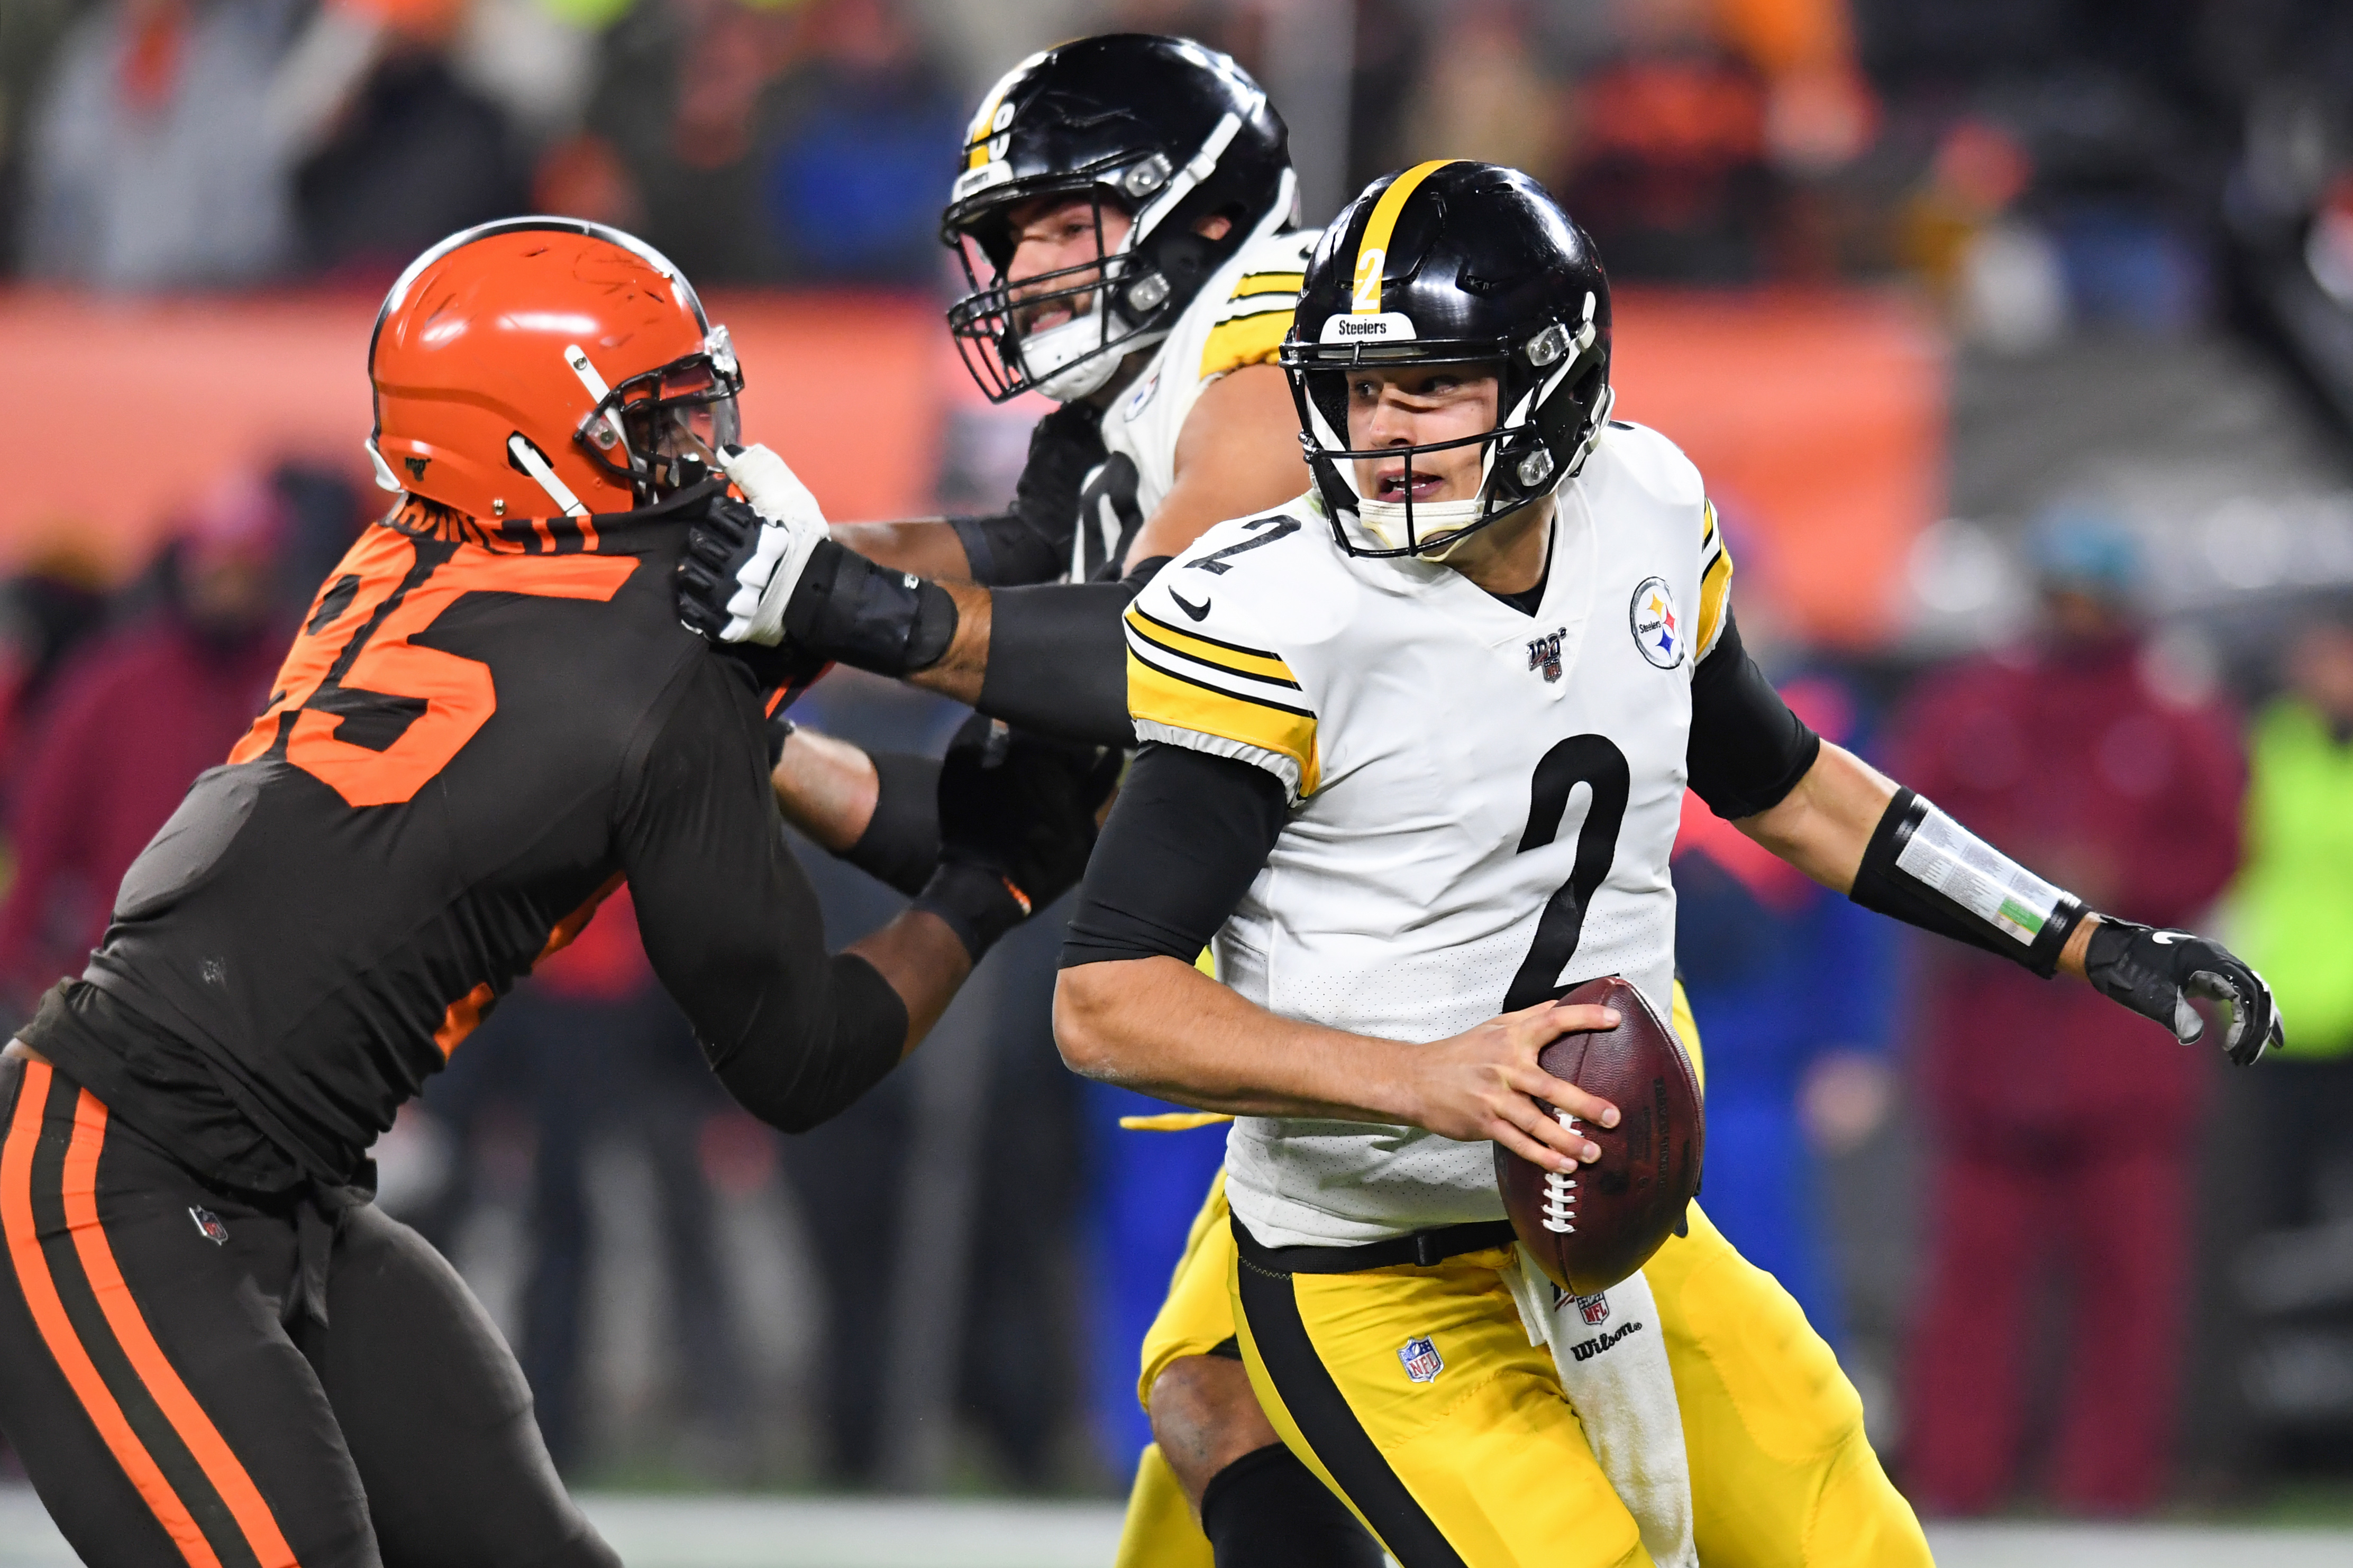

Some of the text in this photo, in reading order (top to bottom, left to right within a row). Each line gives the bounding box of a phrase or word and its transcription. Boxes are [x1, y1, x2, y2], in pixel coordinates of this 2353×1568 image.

[1352, 249, 1385, 310] 2
[1339, 319, 1387, 335] Steelers
[1182, 515, 1301, 575] 2
[1639, 620, 1661, 634] Steelers
[227, 522, 641, 808] 95
[1502, 734, 1630, 1014] 2
[1584, 1303, 1607, 1322] NFL
[1409, 1354, 1438, 1376] NFL
